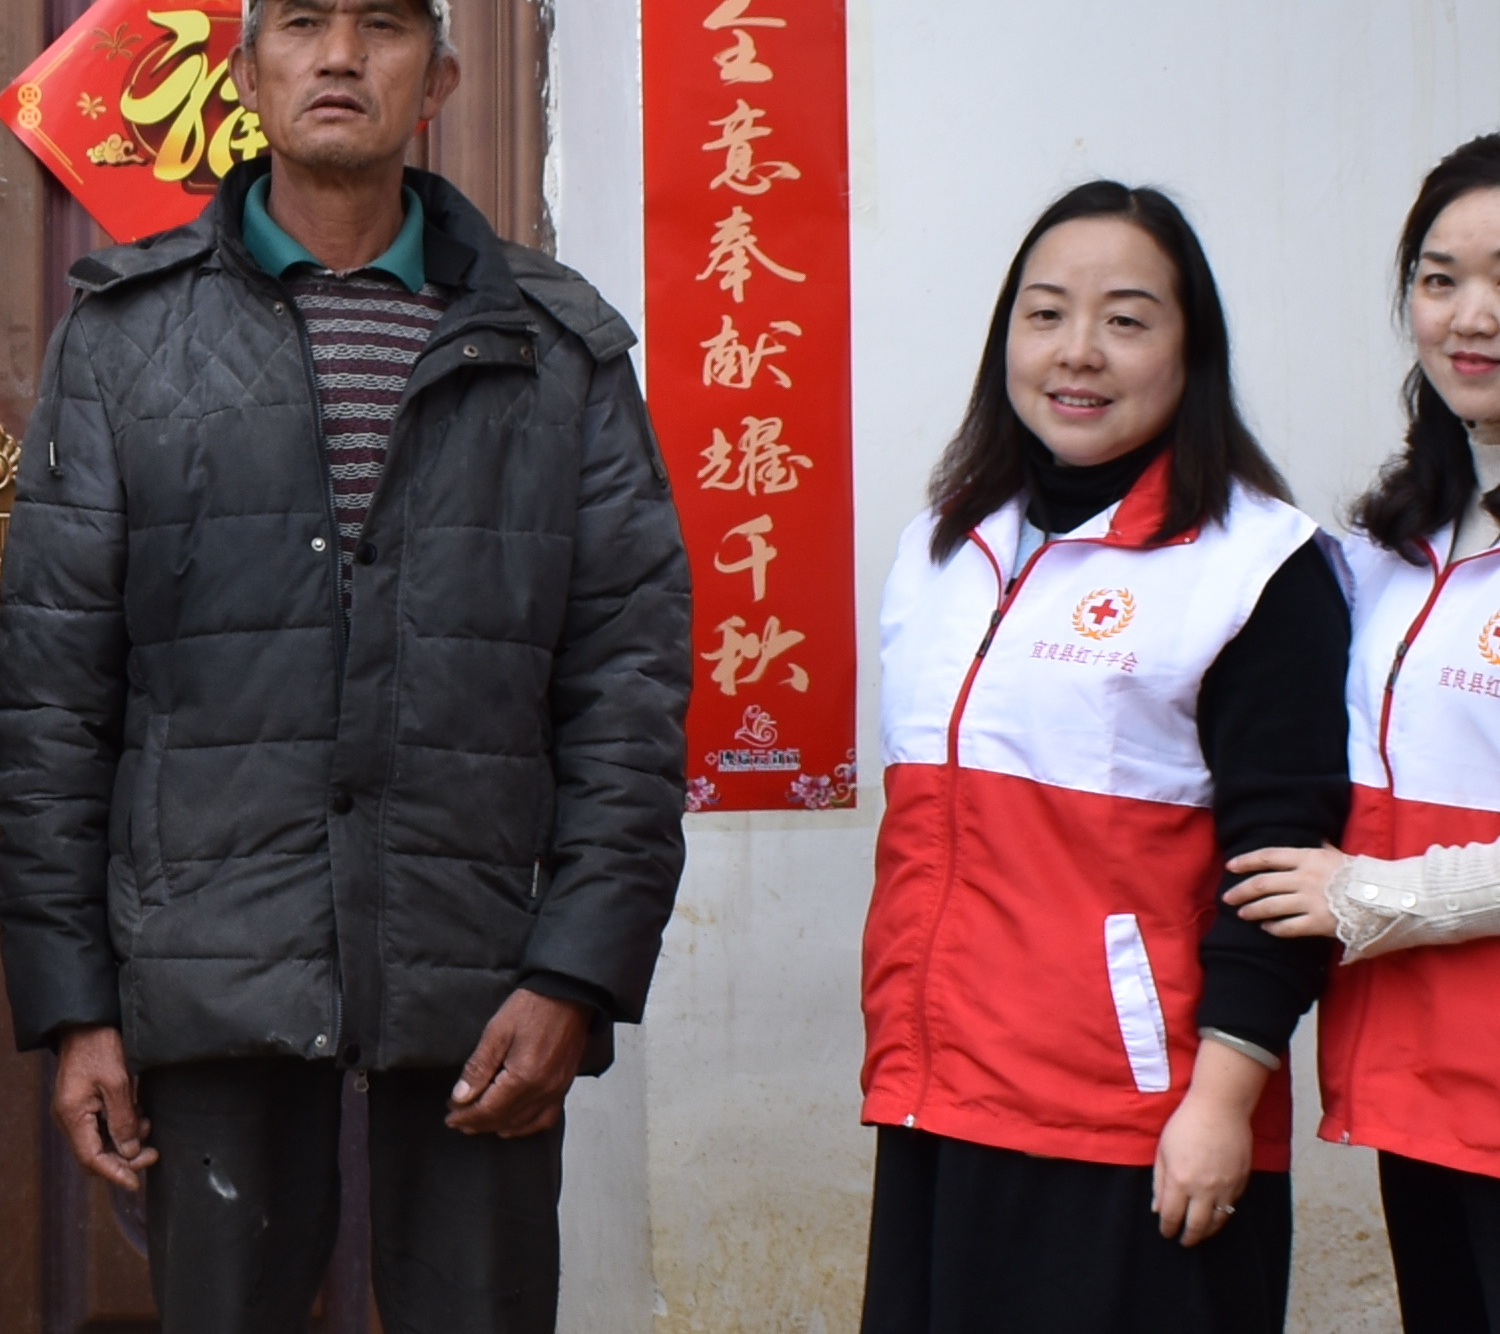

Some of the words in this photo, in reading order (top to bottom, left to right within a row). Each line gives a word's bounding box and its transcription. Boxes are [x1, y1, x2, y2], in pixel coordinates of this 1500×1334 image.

[1030, 640, 1138, 673] 宜良县红十字会
